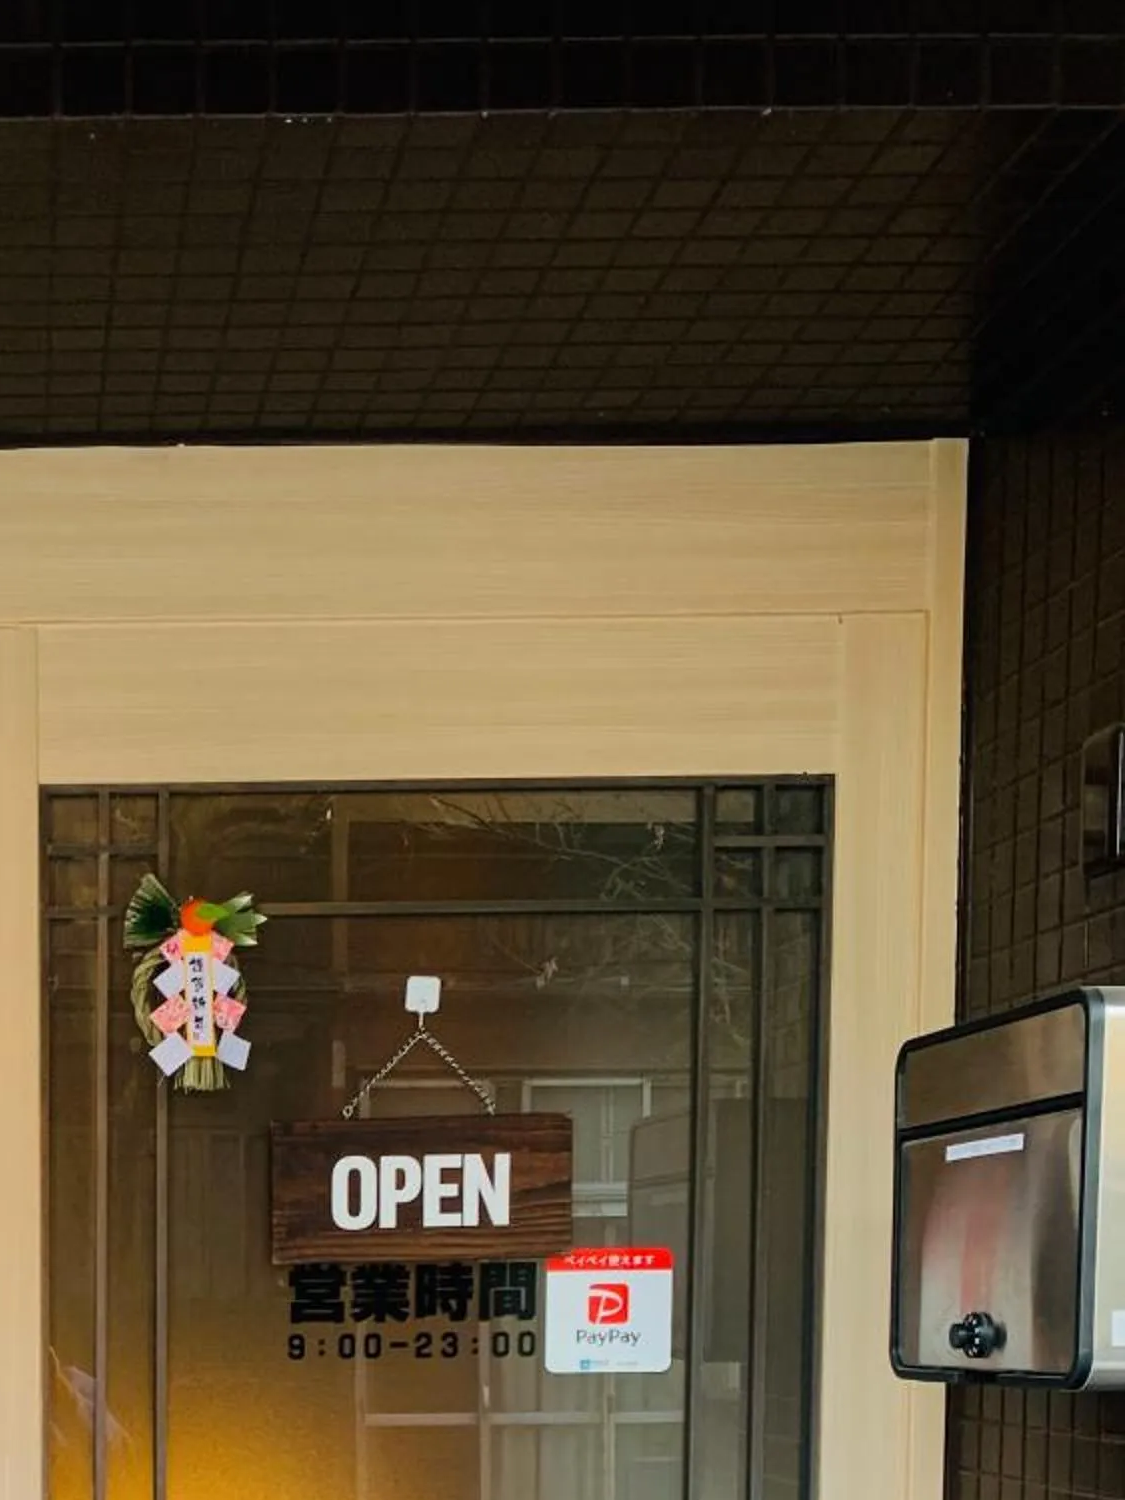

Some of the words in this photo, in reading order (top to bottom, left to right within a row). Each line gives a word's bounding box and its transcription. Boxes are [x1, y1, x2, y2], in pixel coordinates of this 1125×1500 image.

[331, 1153, 512, 1231] OPEN
[289, 1263, 537, 1324] 営業時間
[287, 1332, 537, 1360] 9:00-23:00
[576, 1328, 641, 1346] PayPay
